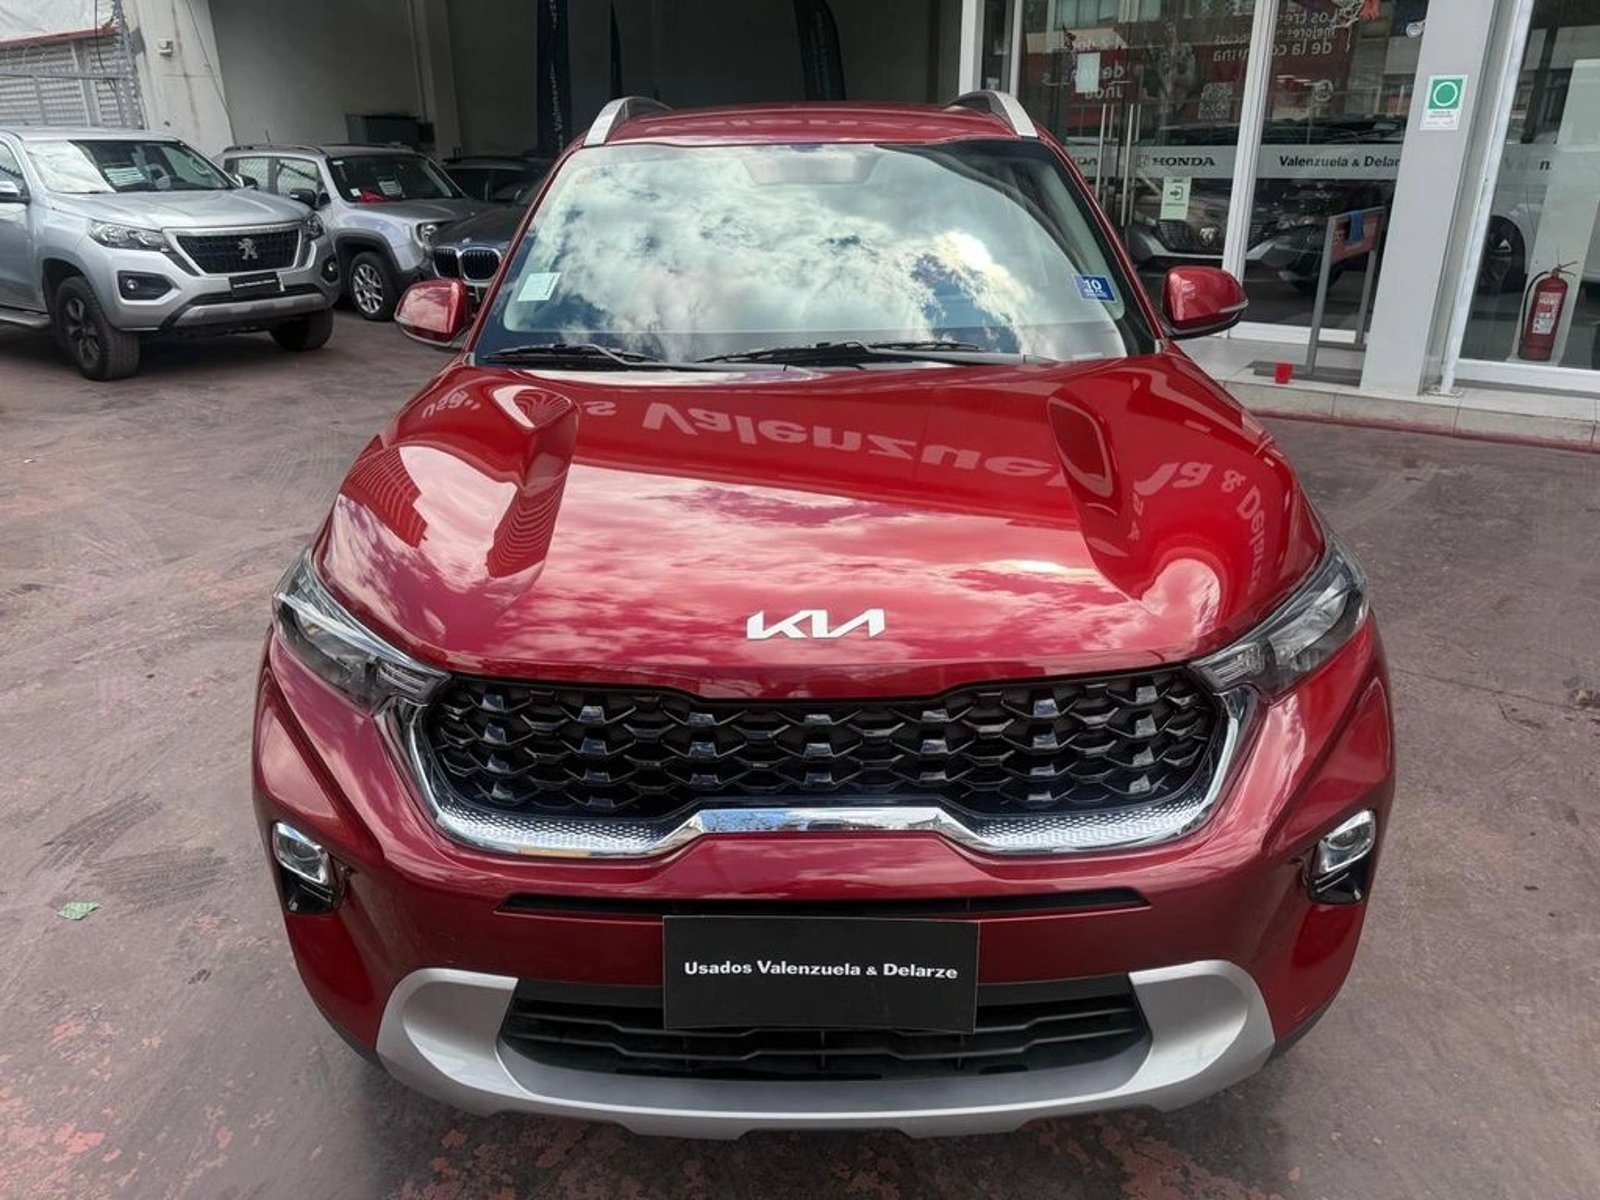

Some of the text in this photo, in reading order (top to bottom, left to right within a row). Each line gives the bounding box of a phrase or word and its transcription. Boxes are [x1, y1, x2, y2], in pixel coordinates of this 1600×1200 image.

[1152, 157, 1216, 166] HONDA
[1279, 155, 1349, 167] Valenzuela
[746, 608, 886, 640] KIA
[684, 960, 959, 979] Usados Valenzuela & Delarze
